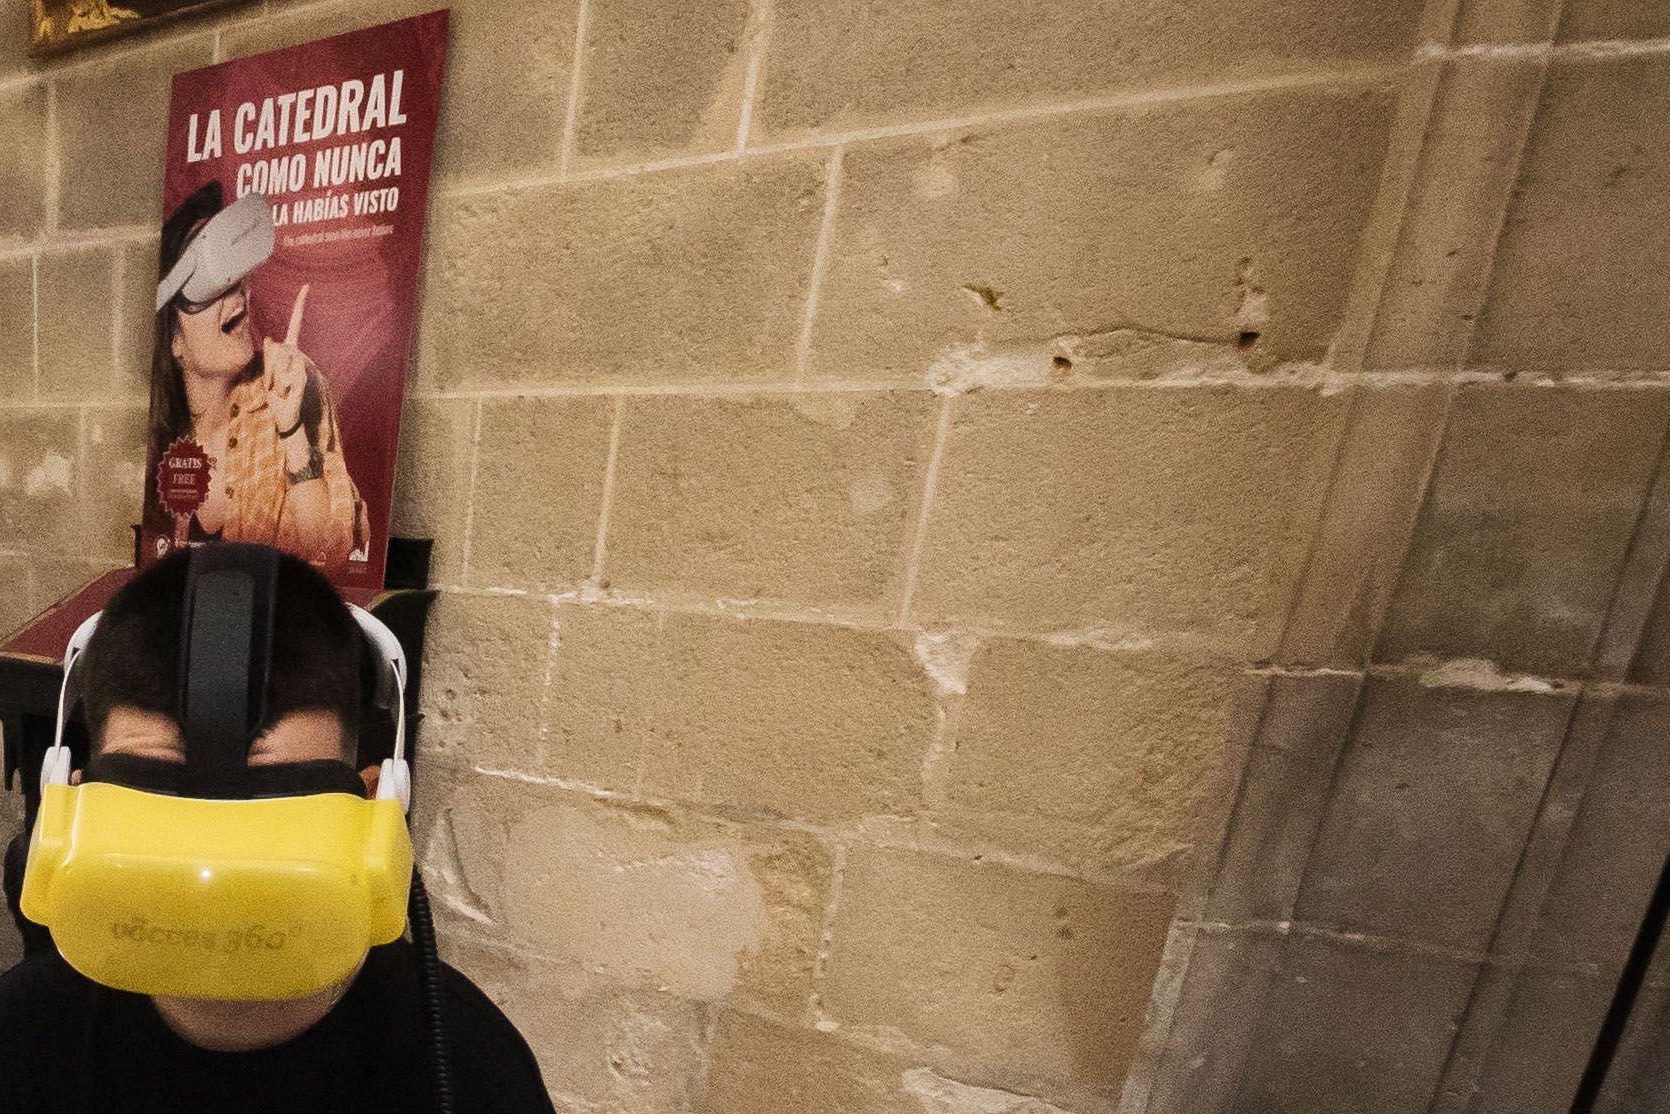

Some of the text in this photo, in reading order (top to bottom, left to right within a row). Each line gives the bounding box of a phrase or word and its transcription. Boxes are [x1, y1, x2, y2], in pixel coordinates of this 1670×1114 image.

[187, 70, 407, 162] LA CATEDRAL
[236, 137, 402, 199] COMO NUNCA
[272, 187, 399, 227] LA HABÍAS VISTO
[168, 457, 202, 469] GRATIS
